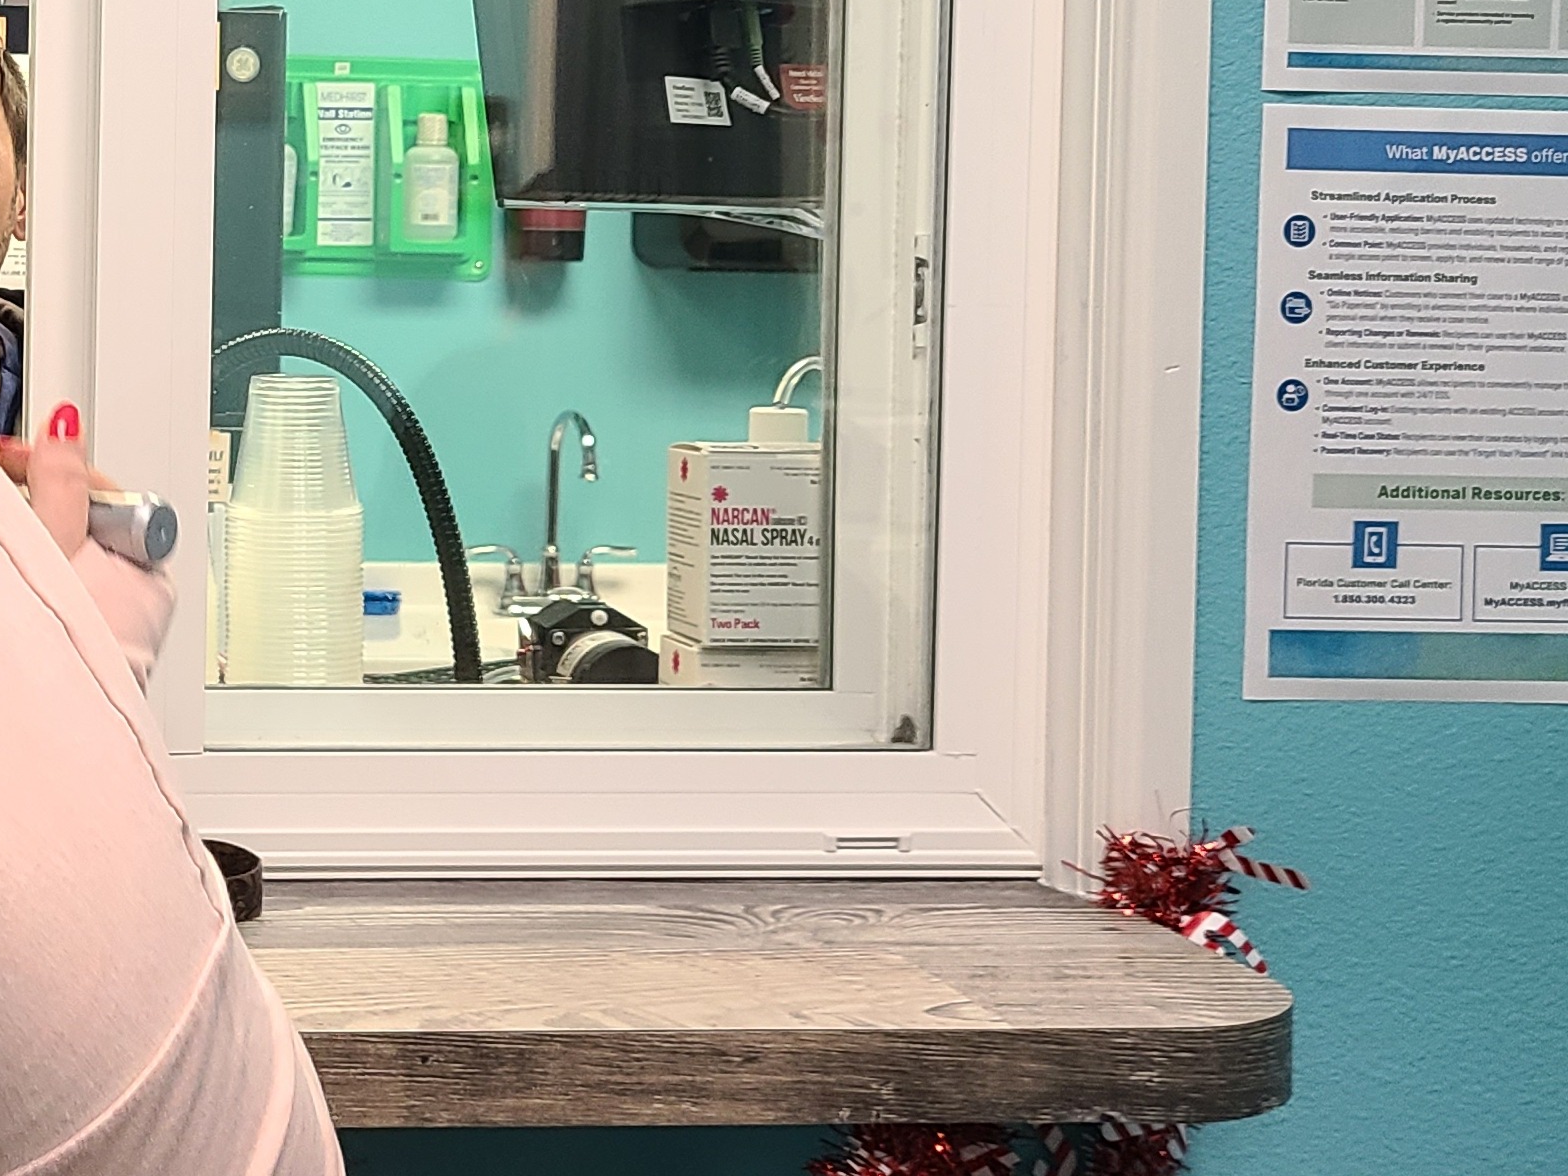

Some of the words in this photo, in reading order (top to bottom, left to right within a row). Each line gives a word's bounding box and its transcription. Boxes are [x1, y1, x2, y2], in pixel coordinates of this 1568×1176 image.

[1385, 144, 1429, 160] What
[1432, 145, 1528, 164] MyACCESS
[1310, 190, 1382, 202] Streamlined
[1381, 191, 1449, 205] Application
[1449, 193, 1497, 205] Process
[1307, 269, 1364, 281] Seamless
[1364, 270, 1432, 283] Information
[1432, 272, 1479, 286] Sharing
[1303, 357, 1362, 369] Enhanced
[1363, 359, 1420, 370] Customer
[1420, 359, 1486, 373] Experience
[1376, 484, 1467, 500] Additional
[1471, 486, 1565, 502] Resources:
[710, 527, 759, 546] NASAL
[761, 527, 807, 547] SPRAY
[1296, 577, 1334, 588] Florida
[1336, 577, 1388, 588] Customer
[1389, 578, 1411, 589] Call
[1412, 579, 1453, 590] Center:
[1509, 581, 1567, 592] MyACCESS
[710, 617, 733, 629] Two
[734, 617, 760, 630] Pack
